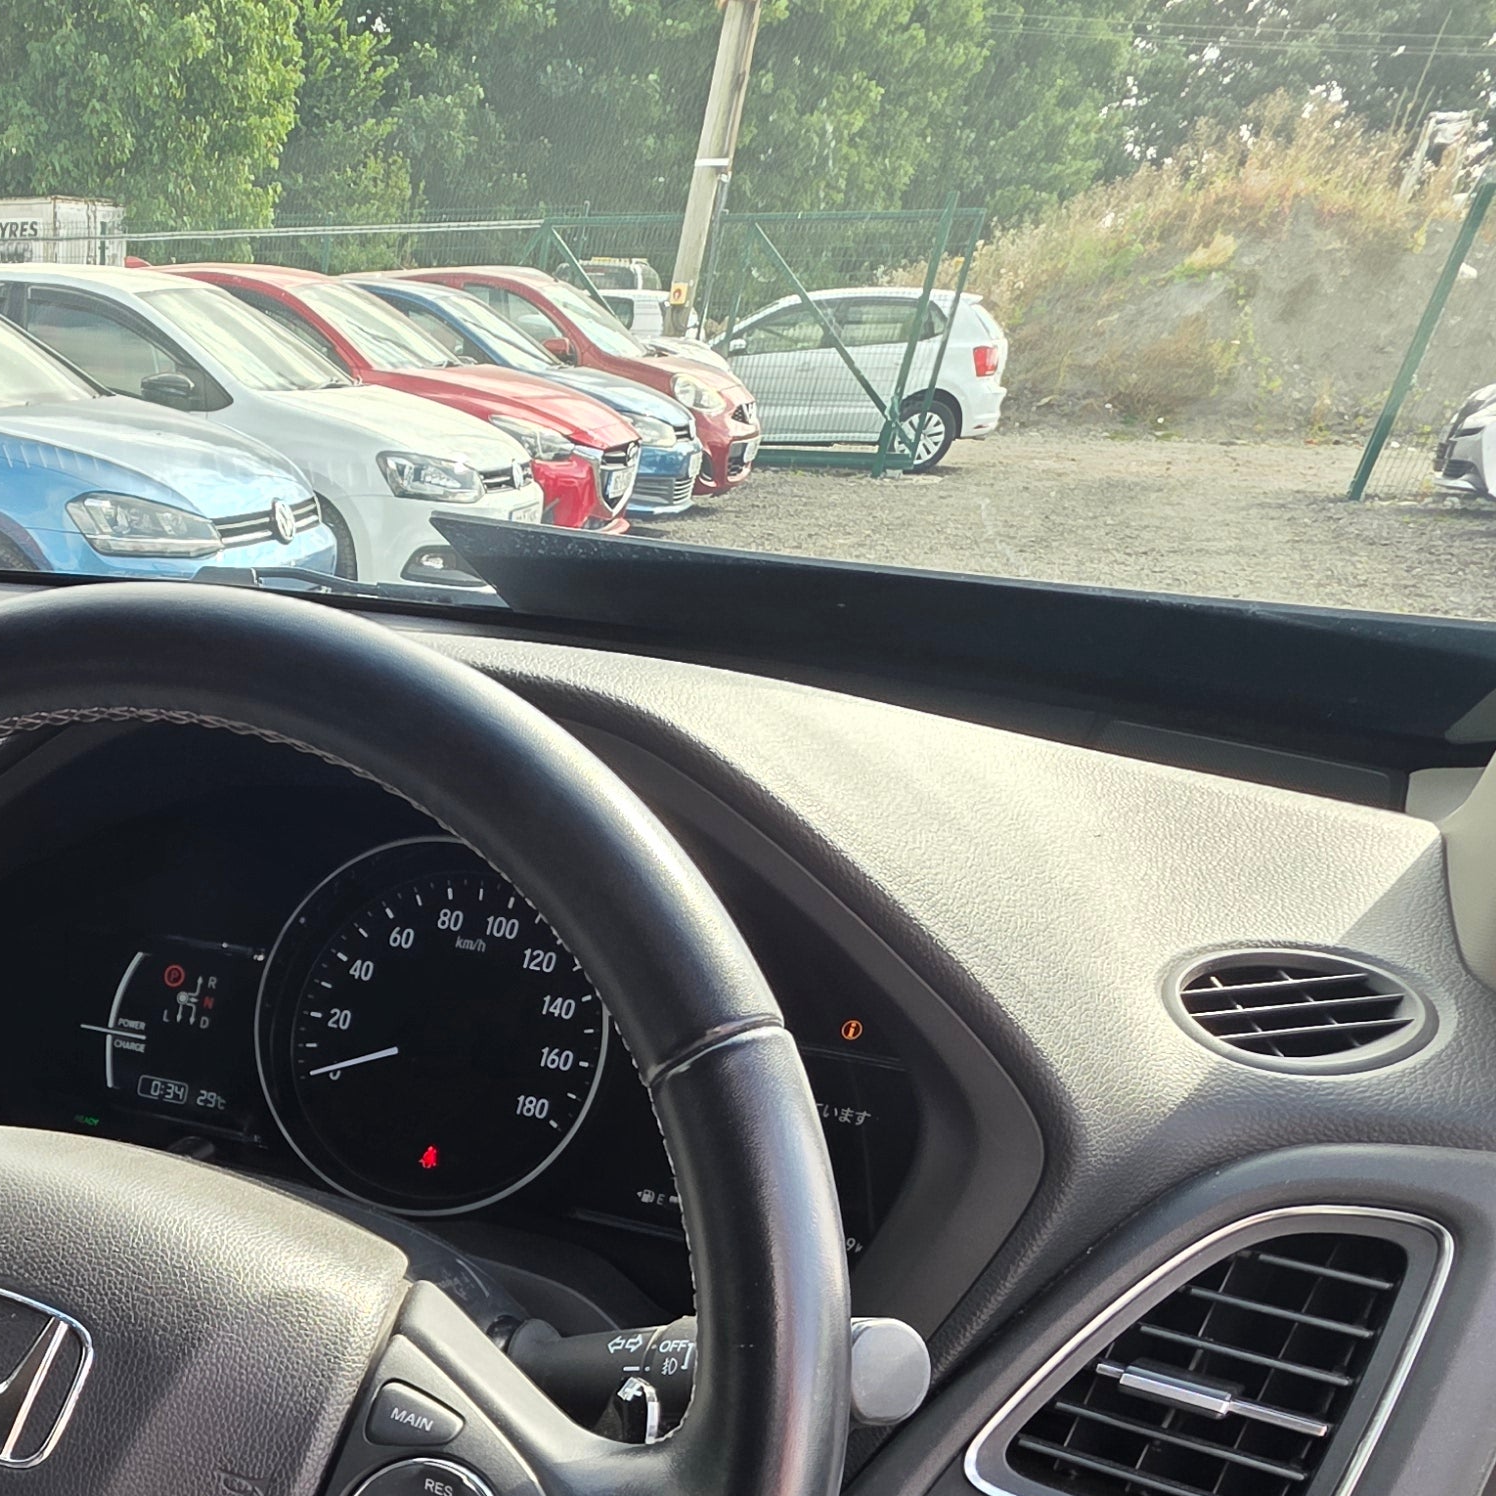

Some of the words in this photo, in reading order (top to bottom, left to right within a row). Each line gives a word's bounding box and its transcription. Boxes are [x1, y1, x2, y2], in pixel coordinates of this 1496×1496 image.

[437, 908, 464, 932] 80
[485, 915, 520, 940] 100
[388, 926, 415, 949] 60
[455, 935, 487, 953] km/h
[348, 960, 374, 981] 40
[522, 948, 557, 973] 120
[207, 976, 217, 990] R
[541, 994, 576, 1020] 140
[199, 1016, 210, 1030] D
[327, 1008, 352, 1030] 20
[539, 1046, 574, 1072] 160
[150, 1080, 185, 1100] 0:34
[515, 1094, 550, 1120] 180
[816, 1103, 872, 1126] います
[659, 1339, 689, 1354] OFF
[390, 1406, 434, 1433] MAIN
